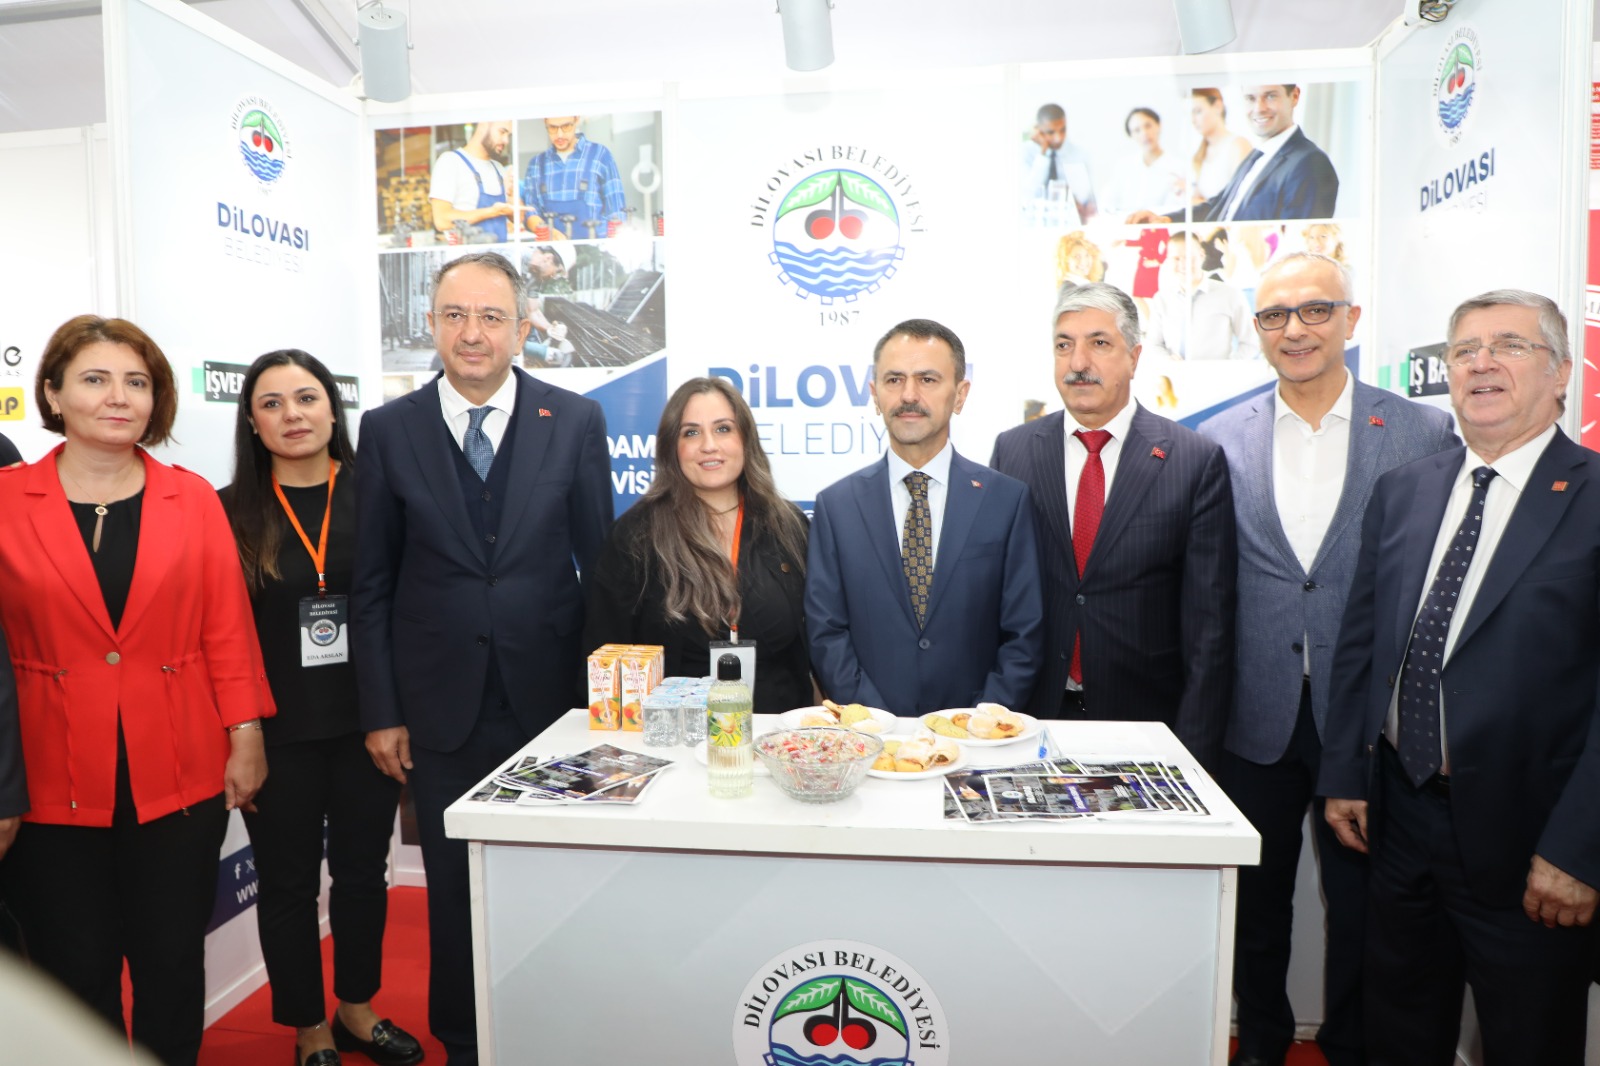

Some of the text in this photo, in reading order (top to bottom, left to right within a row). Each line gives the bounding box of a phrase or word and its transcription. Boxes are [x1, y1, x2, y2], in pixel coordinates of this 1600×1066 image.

[819, 310, 860, 327] 1987
[744, 950, 941, 1050] DİLOVASI BELEDİYESİ
